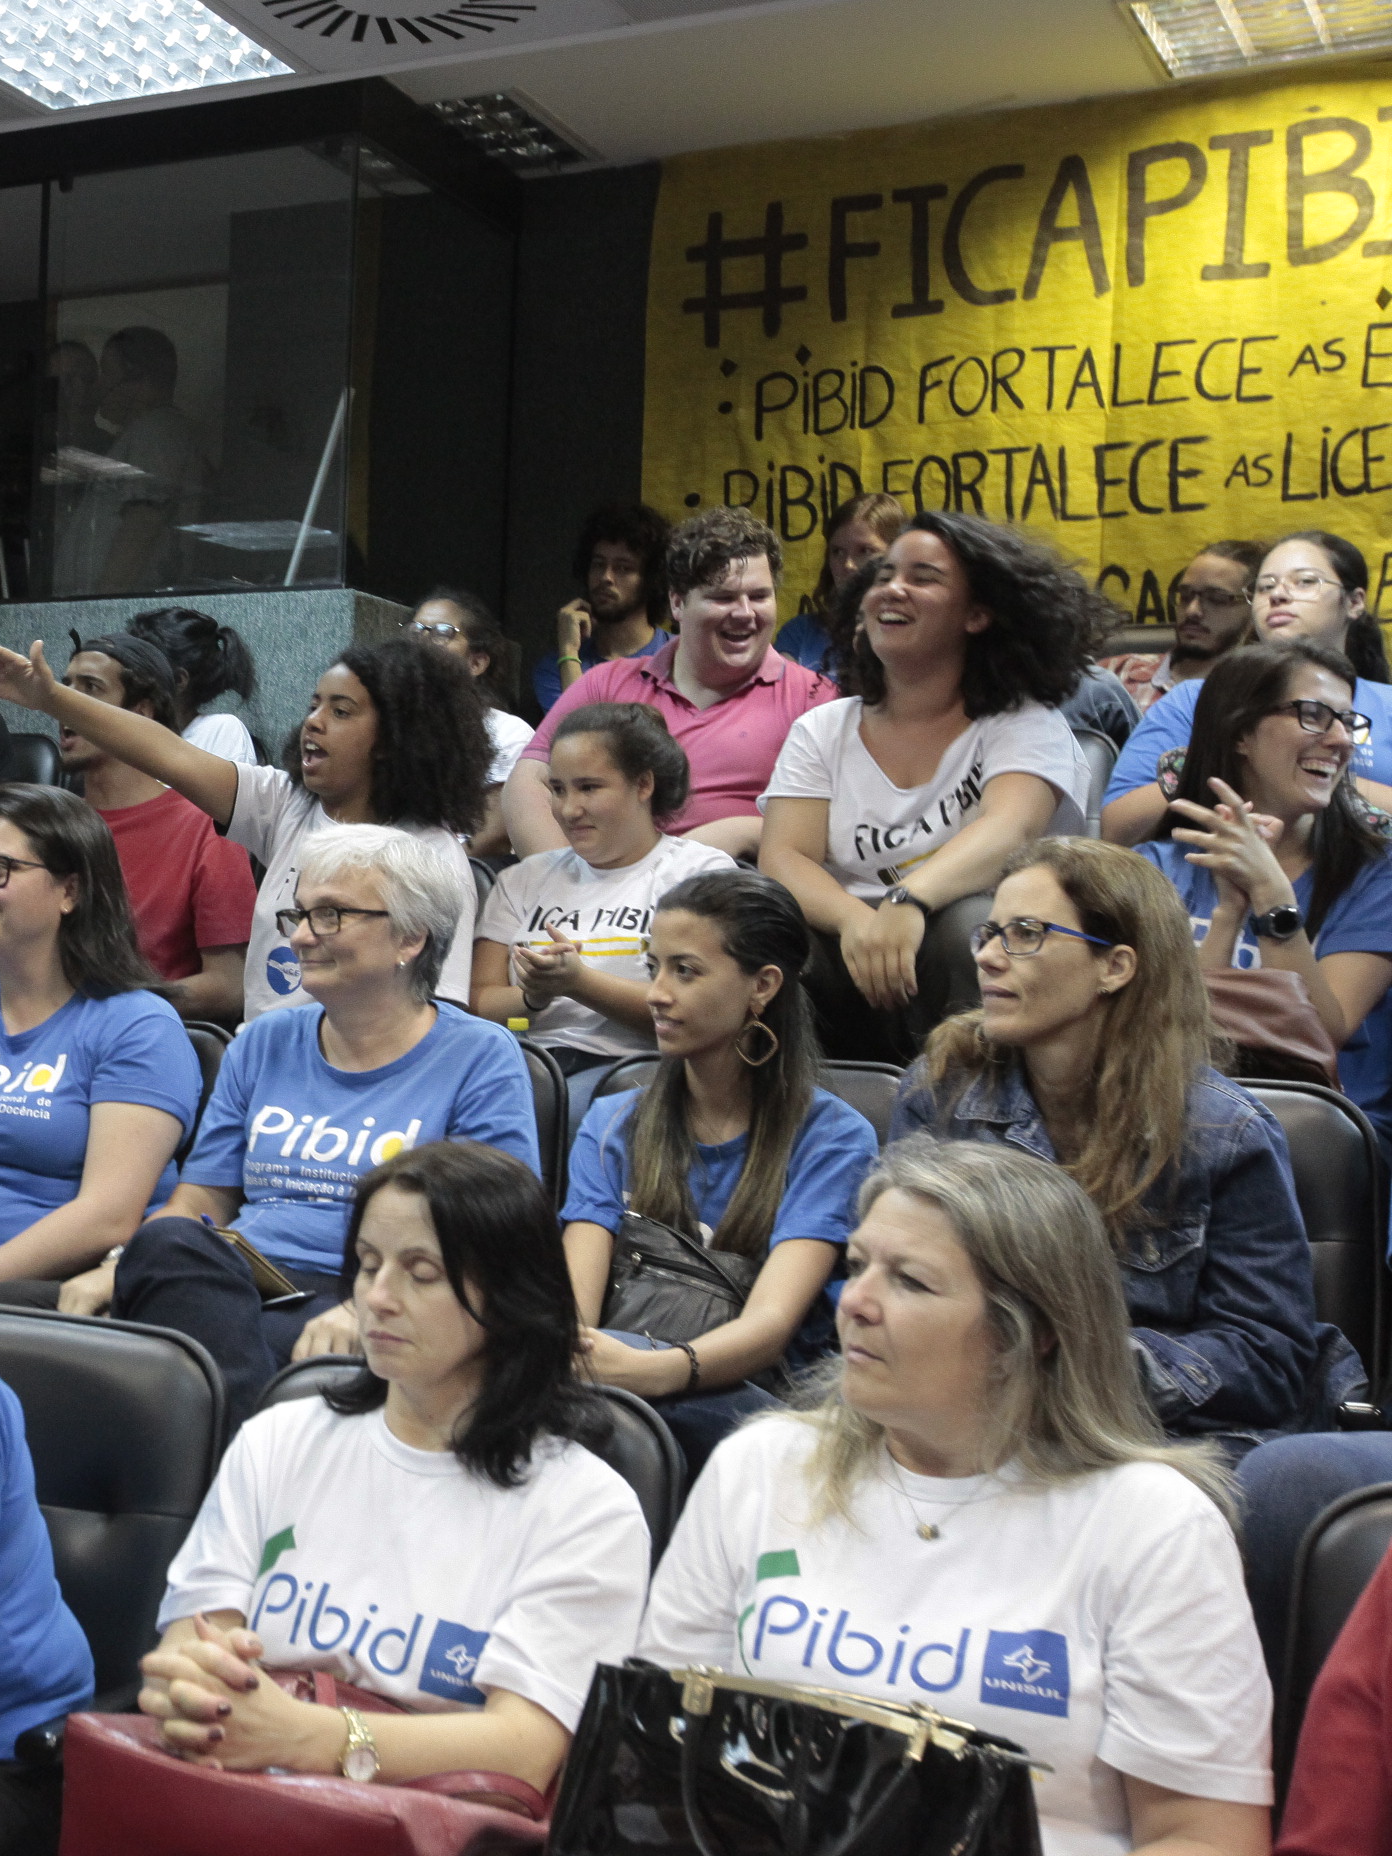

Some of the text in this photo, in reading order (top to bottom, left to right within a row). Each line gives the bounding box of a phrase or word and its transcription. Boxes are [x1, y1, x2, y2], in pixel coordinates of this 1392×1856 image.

[917, 336, 1280, 424] FORTALECE
[1289, 338, 1347, 377] AS
[1225, 454, 1274, 488] AS
[36, 1097, 52, 1107] de
[247, 1105, 422, 1166] Pibid
[251, 1572, 424, 1676] Pibid
[753, 1595, 971, 1692] Pibid
[984, 1676, 1065, 1700] UNISUL
